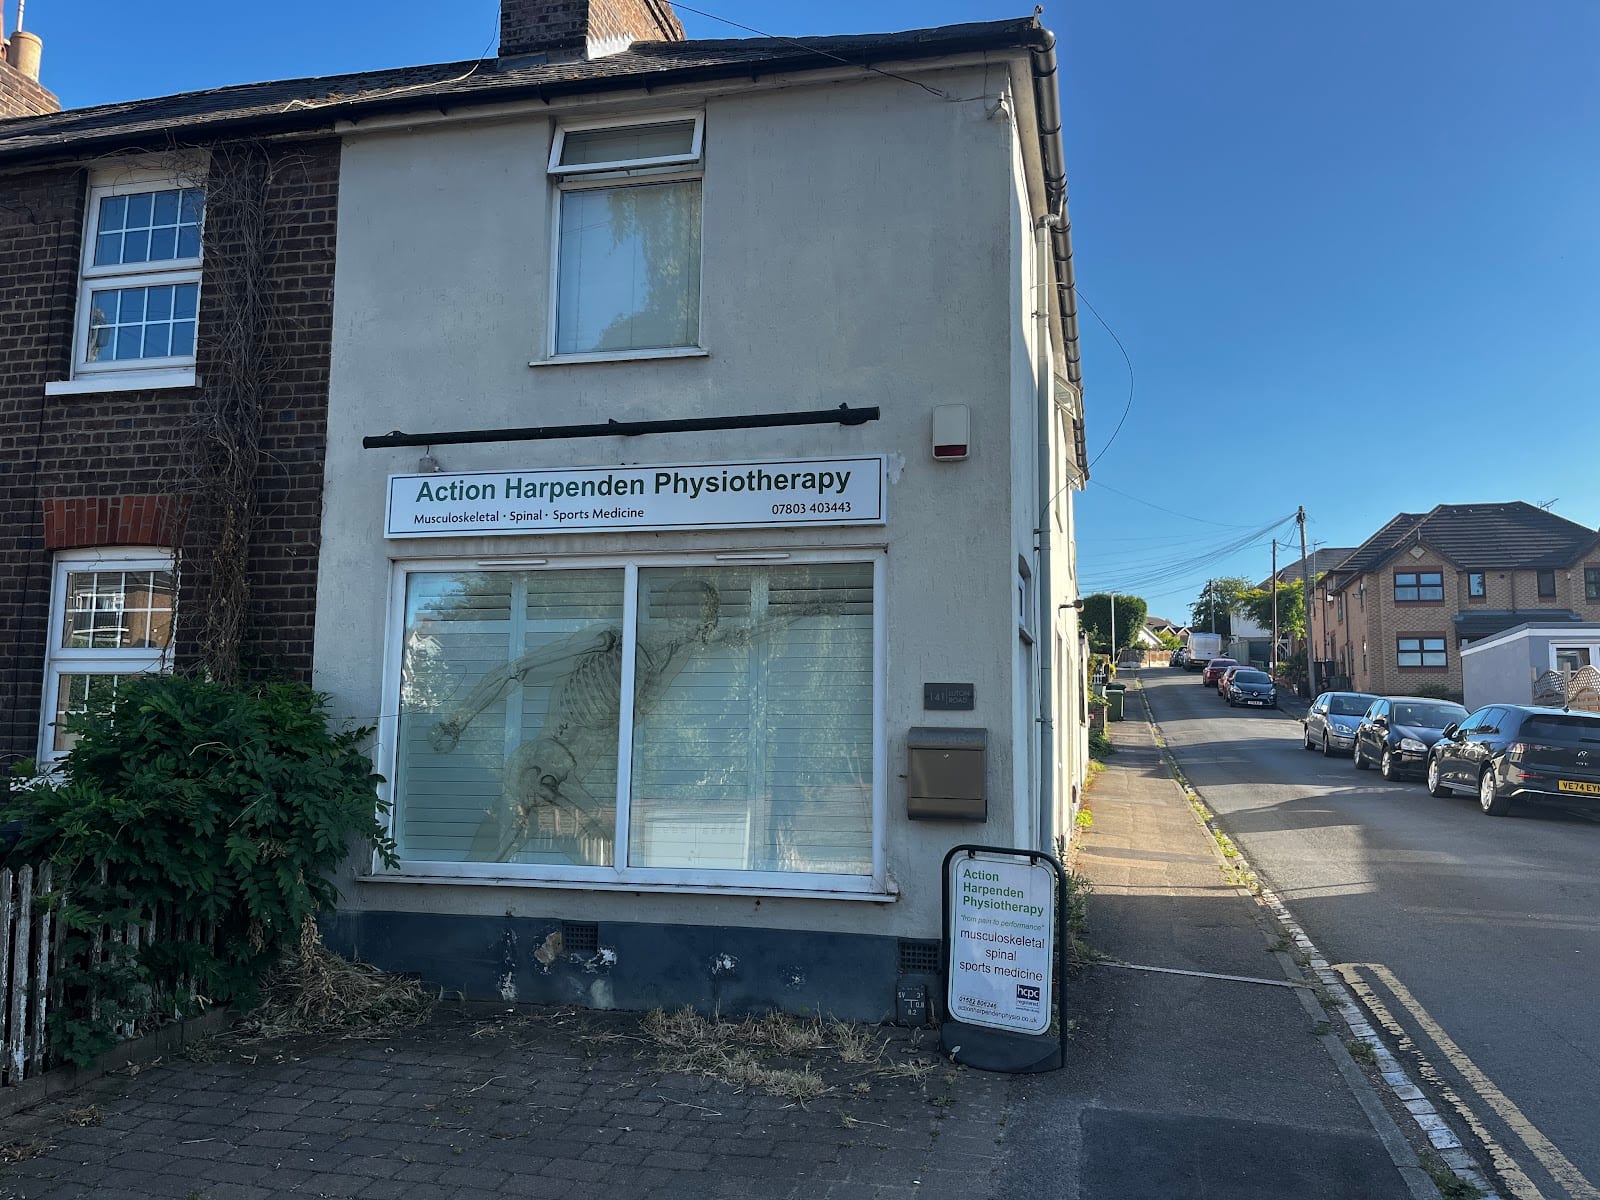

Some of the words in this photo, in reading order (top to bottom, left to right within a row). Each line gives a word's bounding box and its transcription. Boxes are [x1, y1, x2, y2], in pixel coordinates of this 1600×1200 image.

[416, 480, 496, 503] Action
[505, 474, 645, 504] Harpenden
[654, 469, 852, 500] Physiotherapy
[414, 511, 499, 524] Musculoskeletal
[509, 509, 542, 524] Spinal
[553, 508, 589, 523] Sports
[593, 505, 645, 520] Medicine
[771, 503, 807, 515] 07803
[809, 501, 852, 514] 403443
[1563, 782, 1585, 790] VE74
[963, 868, 999, 881] Action
[963, 881, 1024, 898] Harpenden
[963, 895, 1044, 917] Physiotherapy
[1000, 920, 1045, 931] performance"
[960, 929, 1045, 949] musculoskeletal
[985, 948, 1017, 960] spinal
[959, 960, 991, 973] sports
[994, 965, 1043, 981] medicine
[1017, 985, 1039, 998] hcpc
